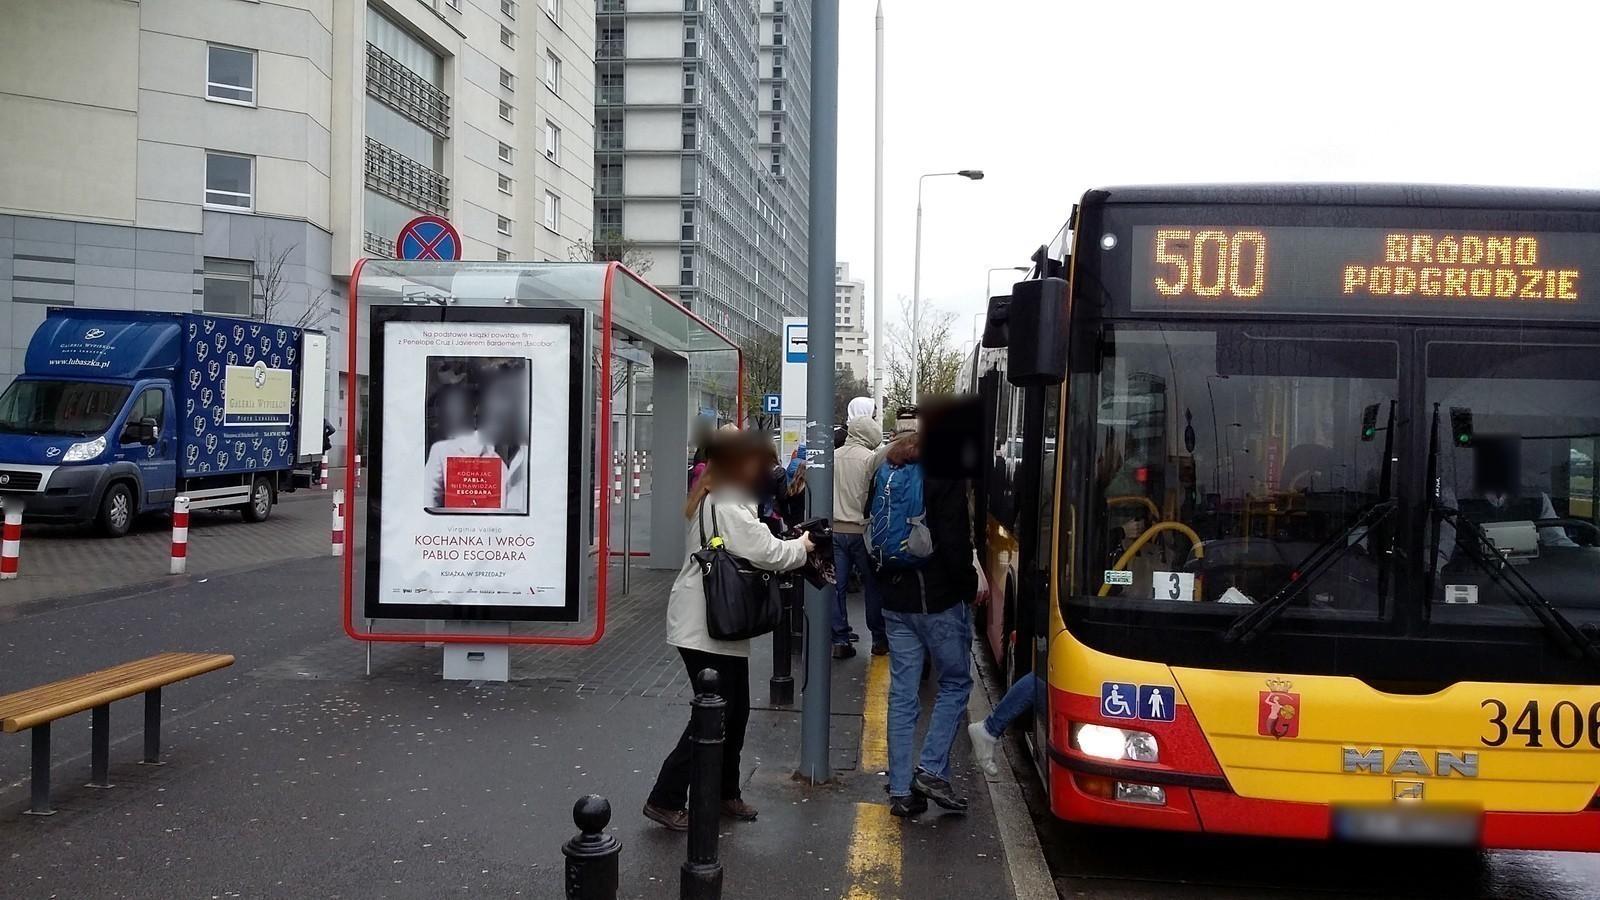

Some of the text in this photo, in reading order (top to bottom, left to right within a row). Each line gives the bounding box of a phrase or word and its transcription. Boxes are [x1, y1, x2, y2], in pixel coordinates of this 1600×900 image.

[1154, 230, 1267, 298] 500
[1343, 265, 1579, 300] PODGRODZIE
[403, 339, 435, 347] Penelope
[433, 331, 468, 340] podstawie
[49, 358, 111, 369] www.lubaszka.pl
[768, 396, 779, 412] P
[414, 535, 484, 546] KOCHANKA
[495, 533, 536, 547] WRÓG
[422, 549, 527, 561] PABLO ESCOBARA
[1168, 573, 1181, 600] 3
[1342, 745, 1480, 778] MAN
